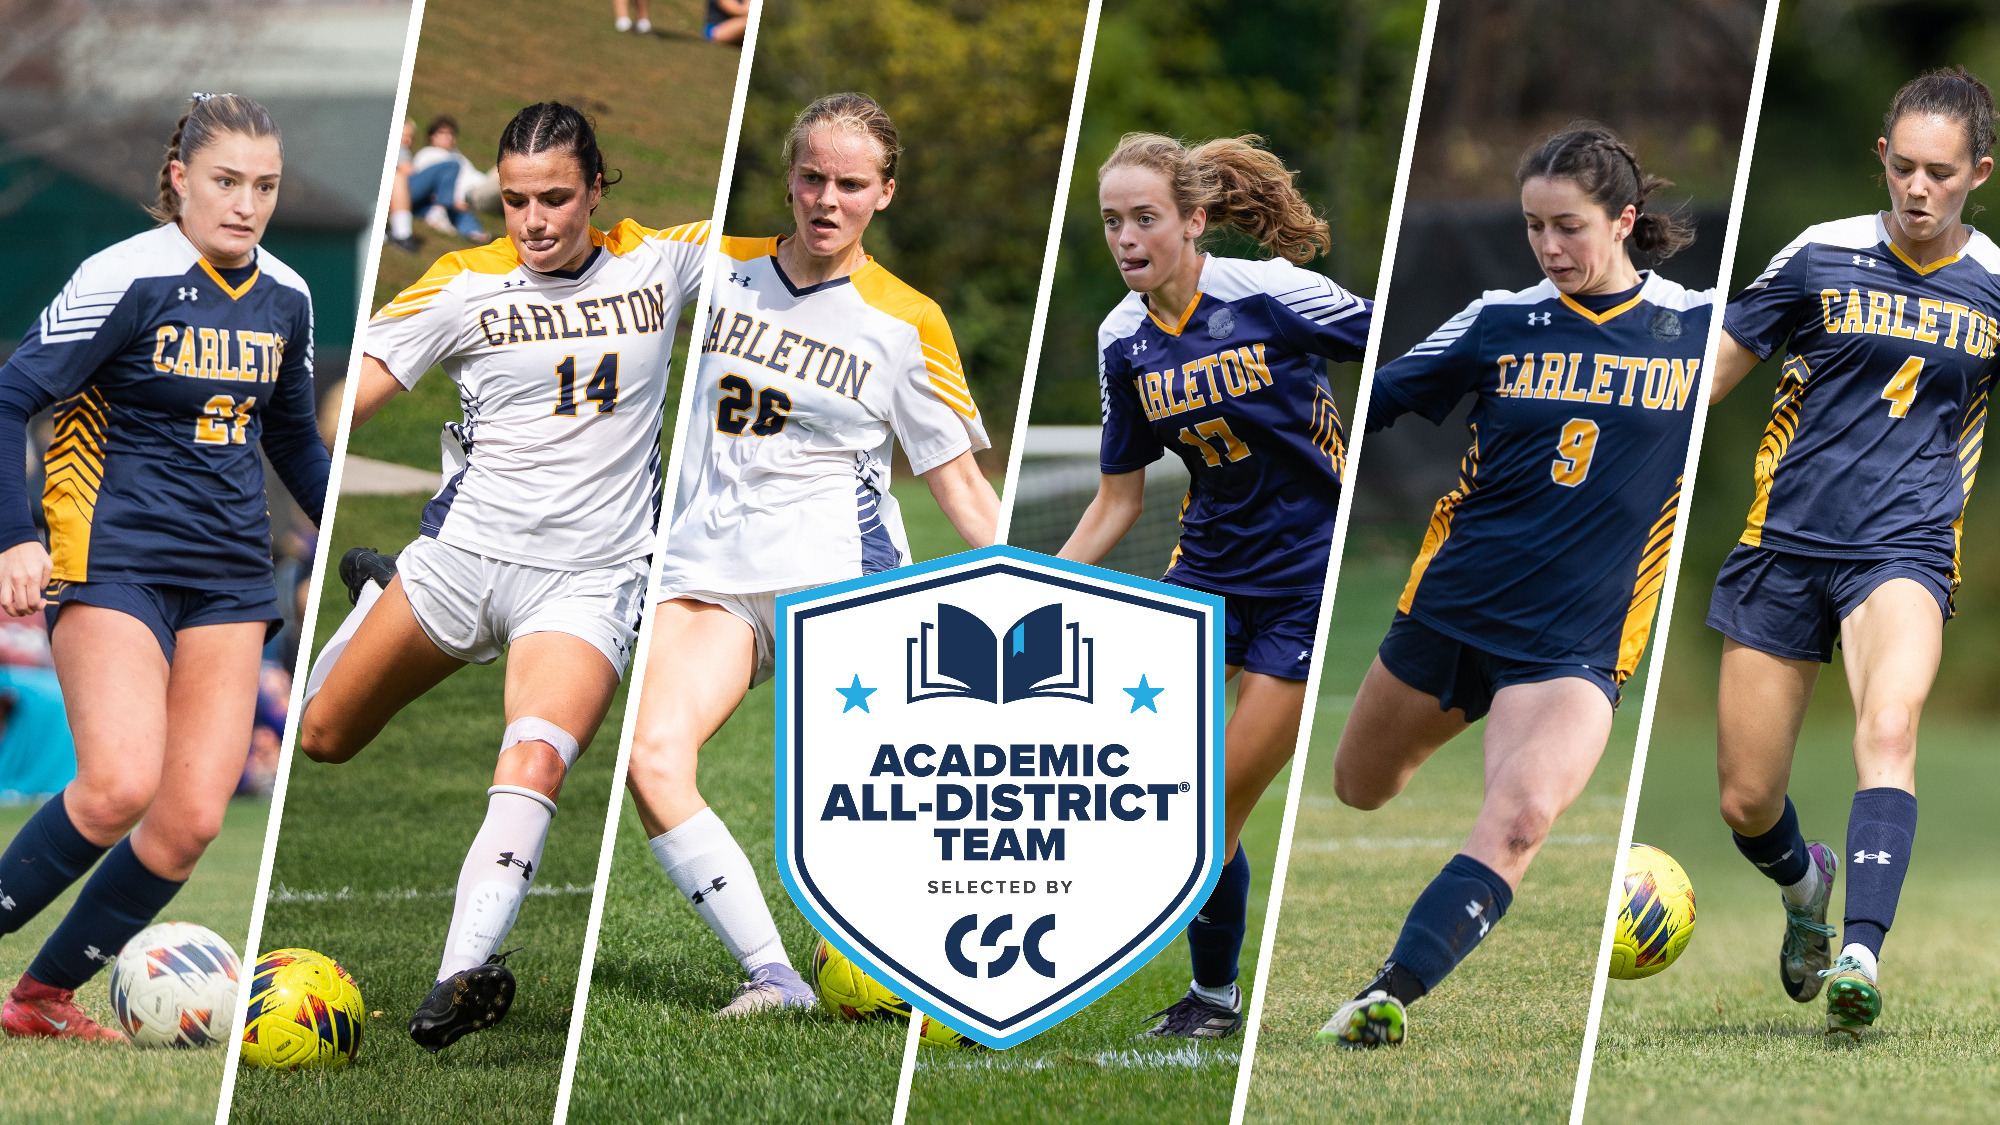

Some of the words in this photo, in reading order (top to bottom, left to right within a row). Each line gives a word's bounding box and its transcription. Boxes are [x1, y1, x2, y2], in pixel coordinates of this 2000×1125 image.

[479, 282, 665, 347] CARLETON
[153, 325, 287, 382] CARLETO
[552, 352, 620, 417] 14
[1133, 343, 1273, 422] ARLETON
[1496, 353, 1700, 411] CARLETON
[715, 372, 793, 438] 26
[1881, 355, 1925, 418] 4
[1178, 417, 1252, 467] 17
[1551, 418, 1600, 488] 9
